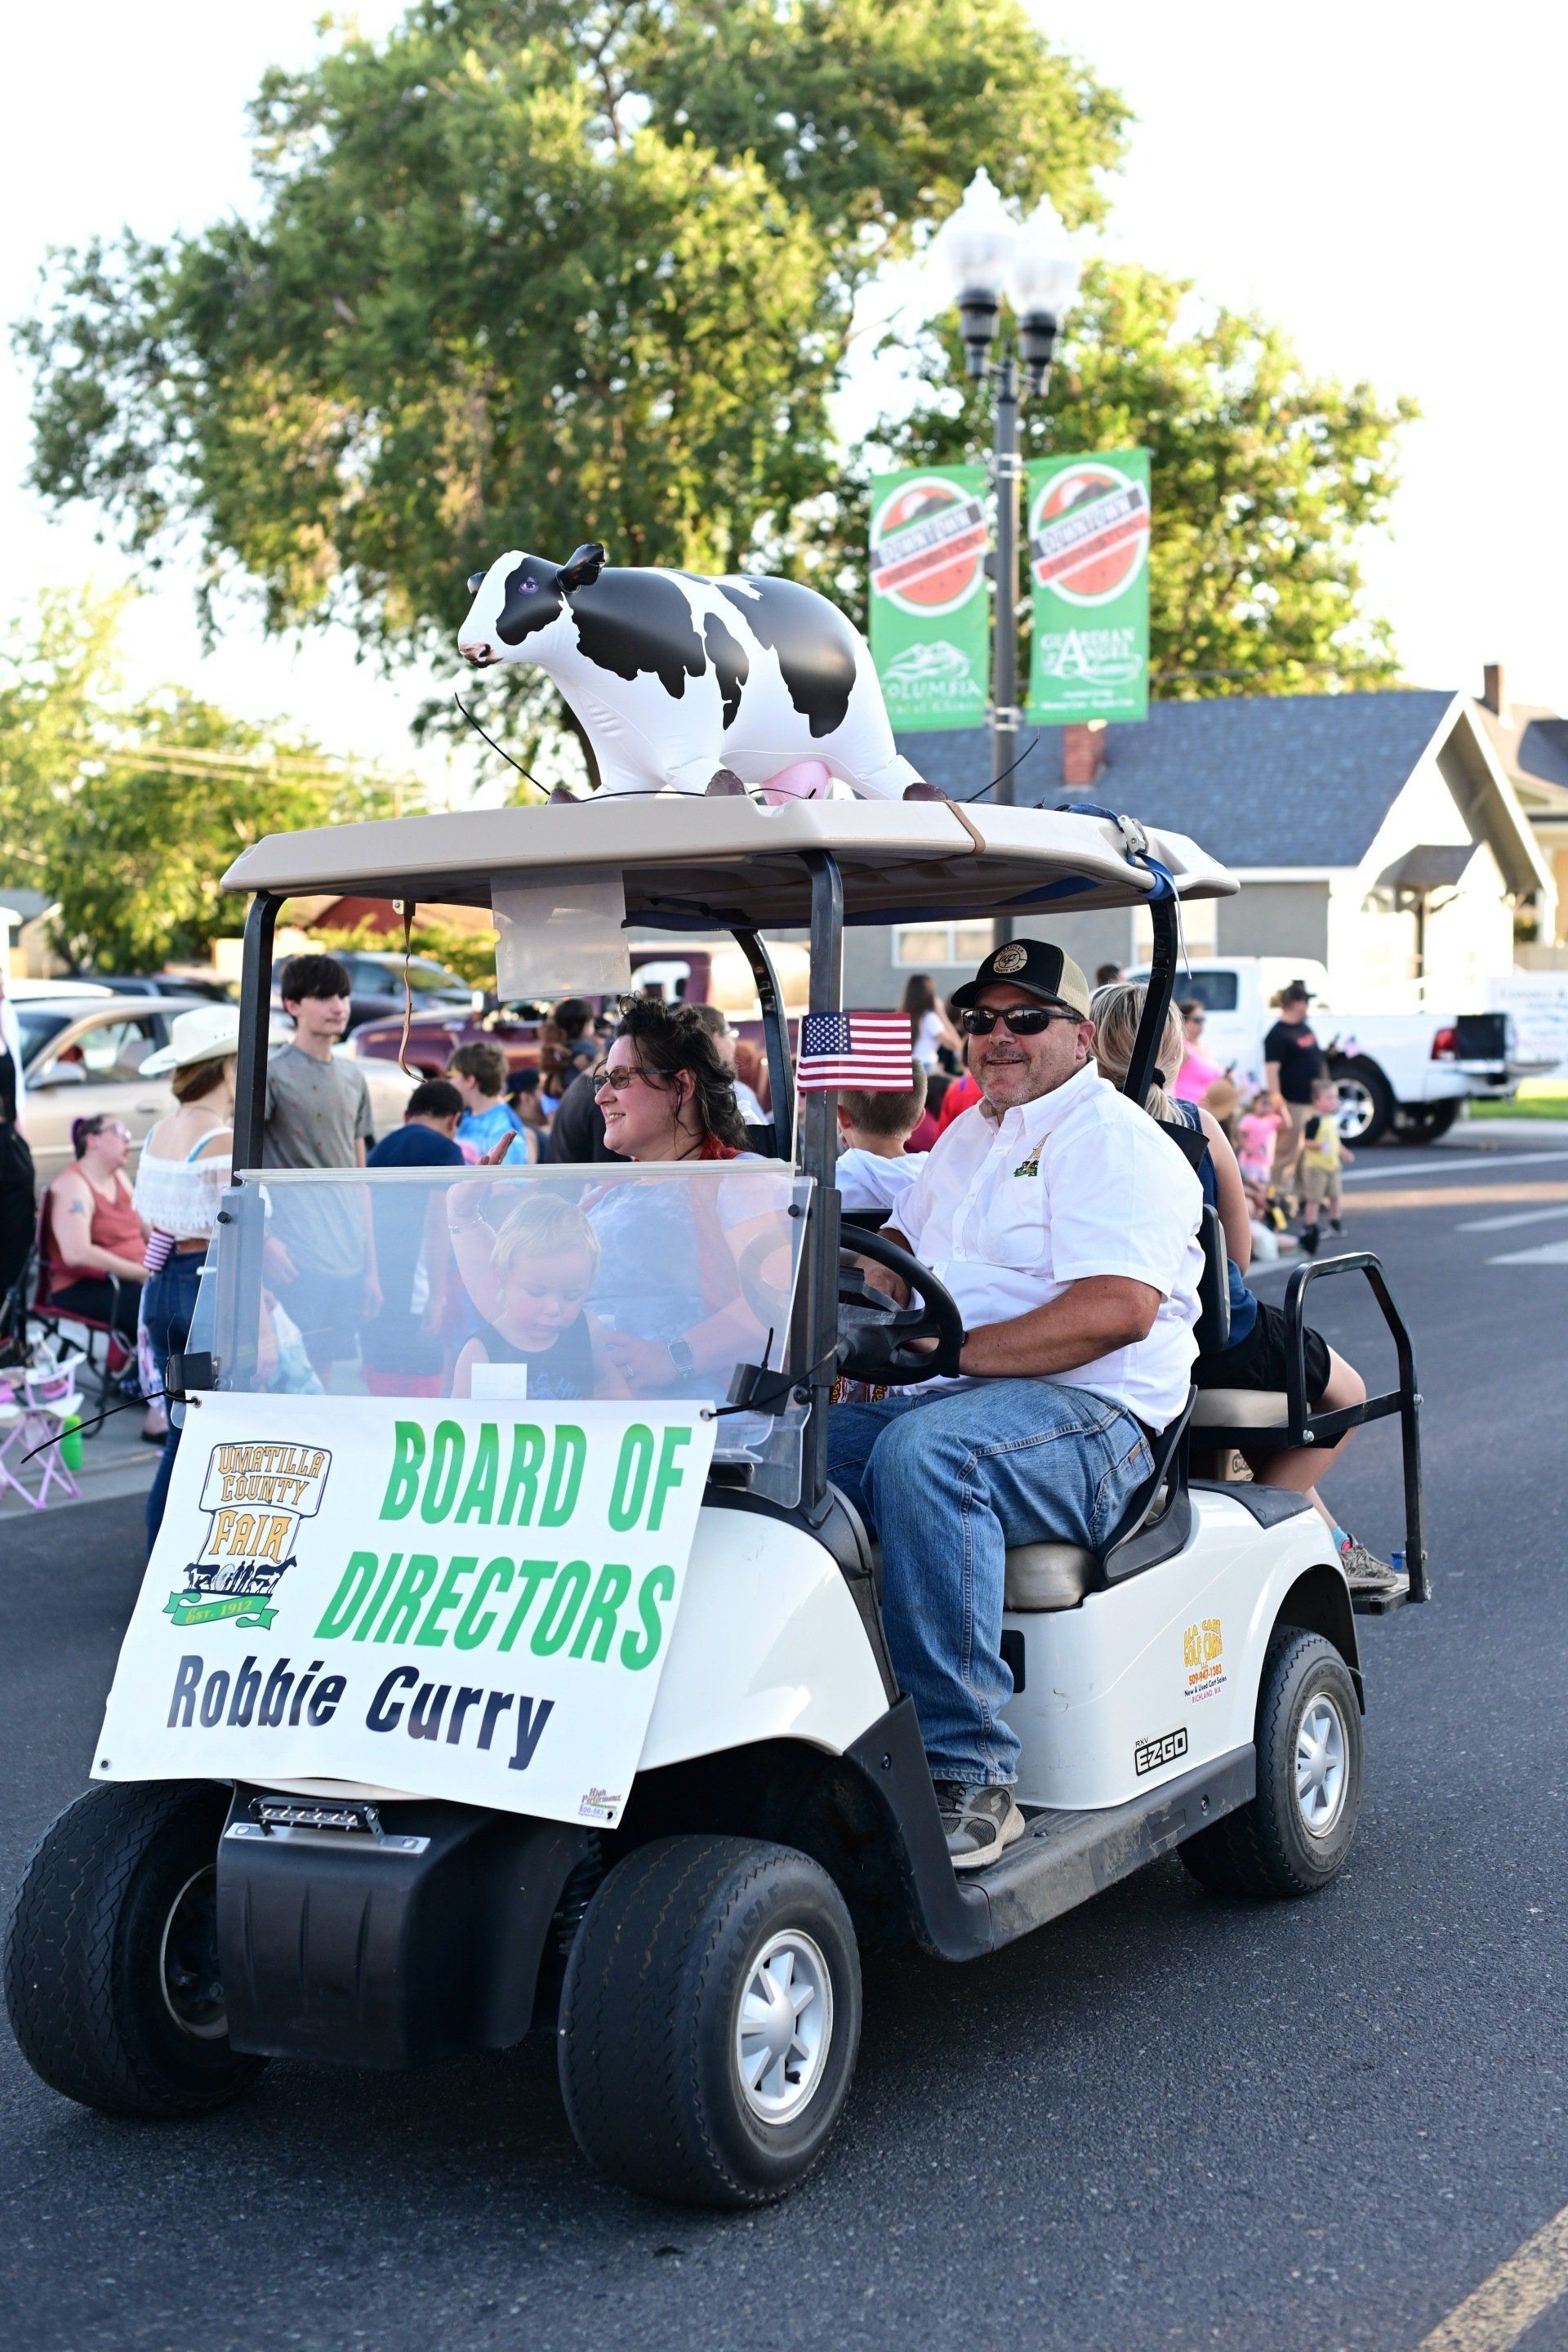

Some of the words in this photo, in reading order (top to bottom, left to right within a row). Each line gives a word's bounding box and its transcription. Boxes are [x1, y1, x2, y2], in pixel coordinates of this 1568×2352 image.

[218, 1446, 325, 1478] UMATILLA
[378, 1419, 587, 1527] BOARD
[608, 1423, 693, 1532] OF
[221, 1474, 310, 1505] COUNTY
[208, 1509, 292, 1564] FAIR
[220, 1600, 252, 1615] 1912
[314, 1551, 676, 1671] DIRECTORS
[1184, 1635, 1201, 1668] GOLF
[1184, 1688, 1194, 1697] New
[1198, 1682, 1208, 1691] Used
[1208, 1678, 1216, 1688] Cart
[1216, 1675, 1227, 1685] Sales
[167, 1655, 347, 1728] Robbie
[365, 1665, 555, 1771] Curry
[1135, 1735, 1148, 1748] RXV
[590, 1788, 606, 1797] High
